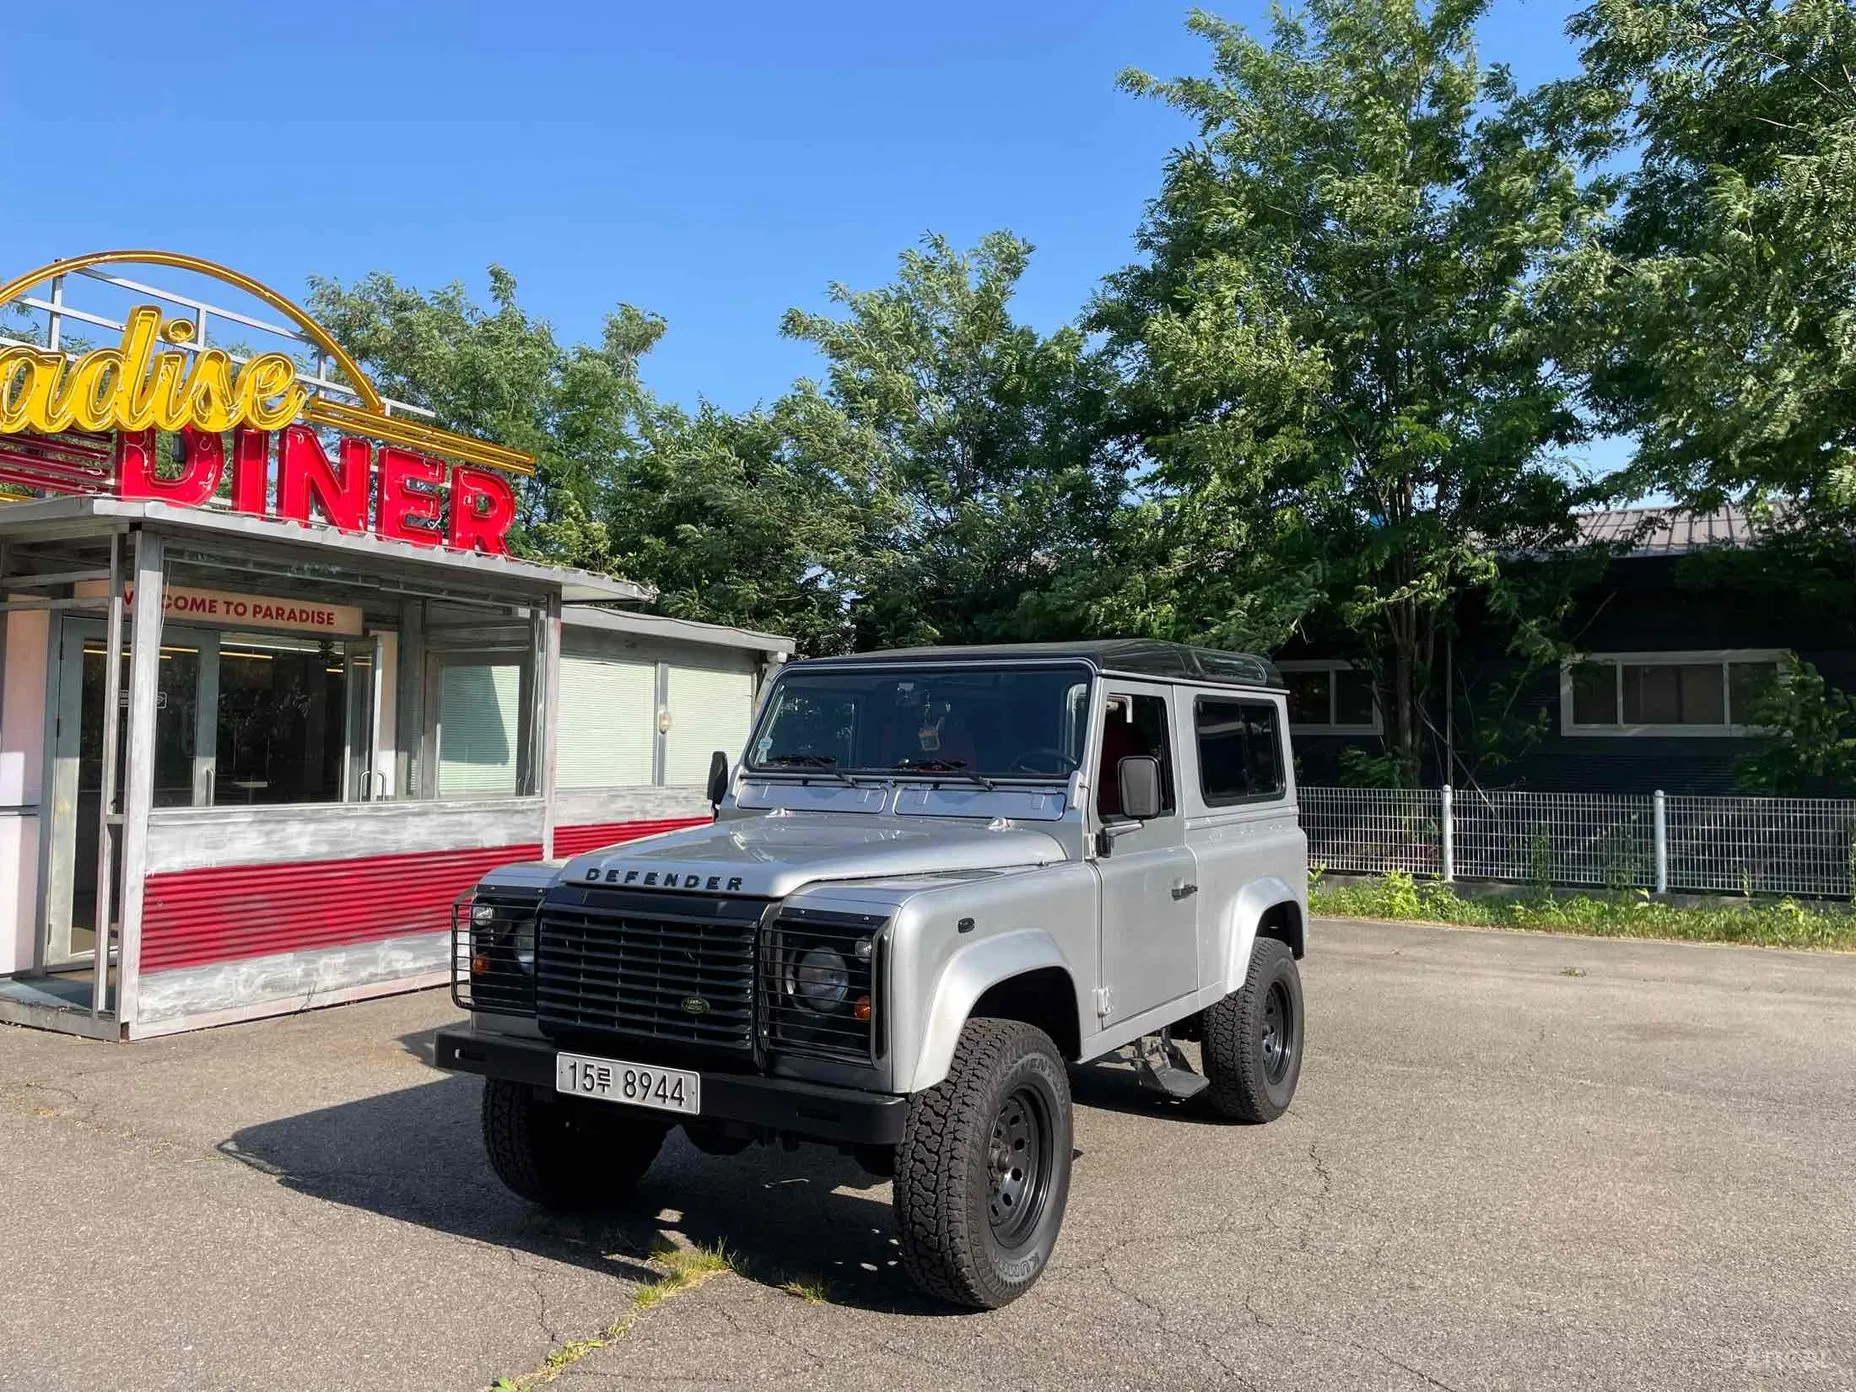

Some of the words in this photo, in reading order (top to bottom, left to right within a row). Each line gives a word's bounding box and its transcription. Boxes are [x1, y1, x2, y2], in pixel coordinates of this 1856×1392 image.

[115, 424, 517, 557] DINER
[124, 590, 217, 614] COME
[223, 601, 248, 616] TO
[253, 604, 335, 626] PARADISE
[585, 868, 744, 891] DEFENDER
[569, 1061, 611, 1093] 15루
[624, 1069, 686, 1107] 8944
